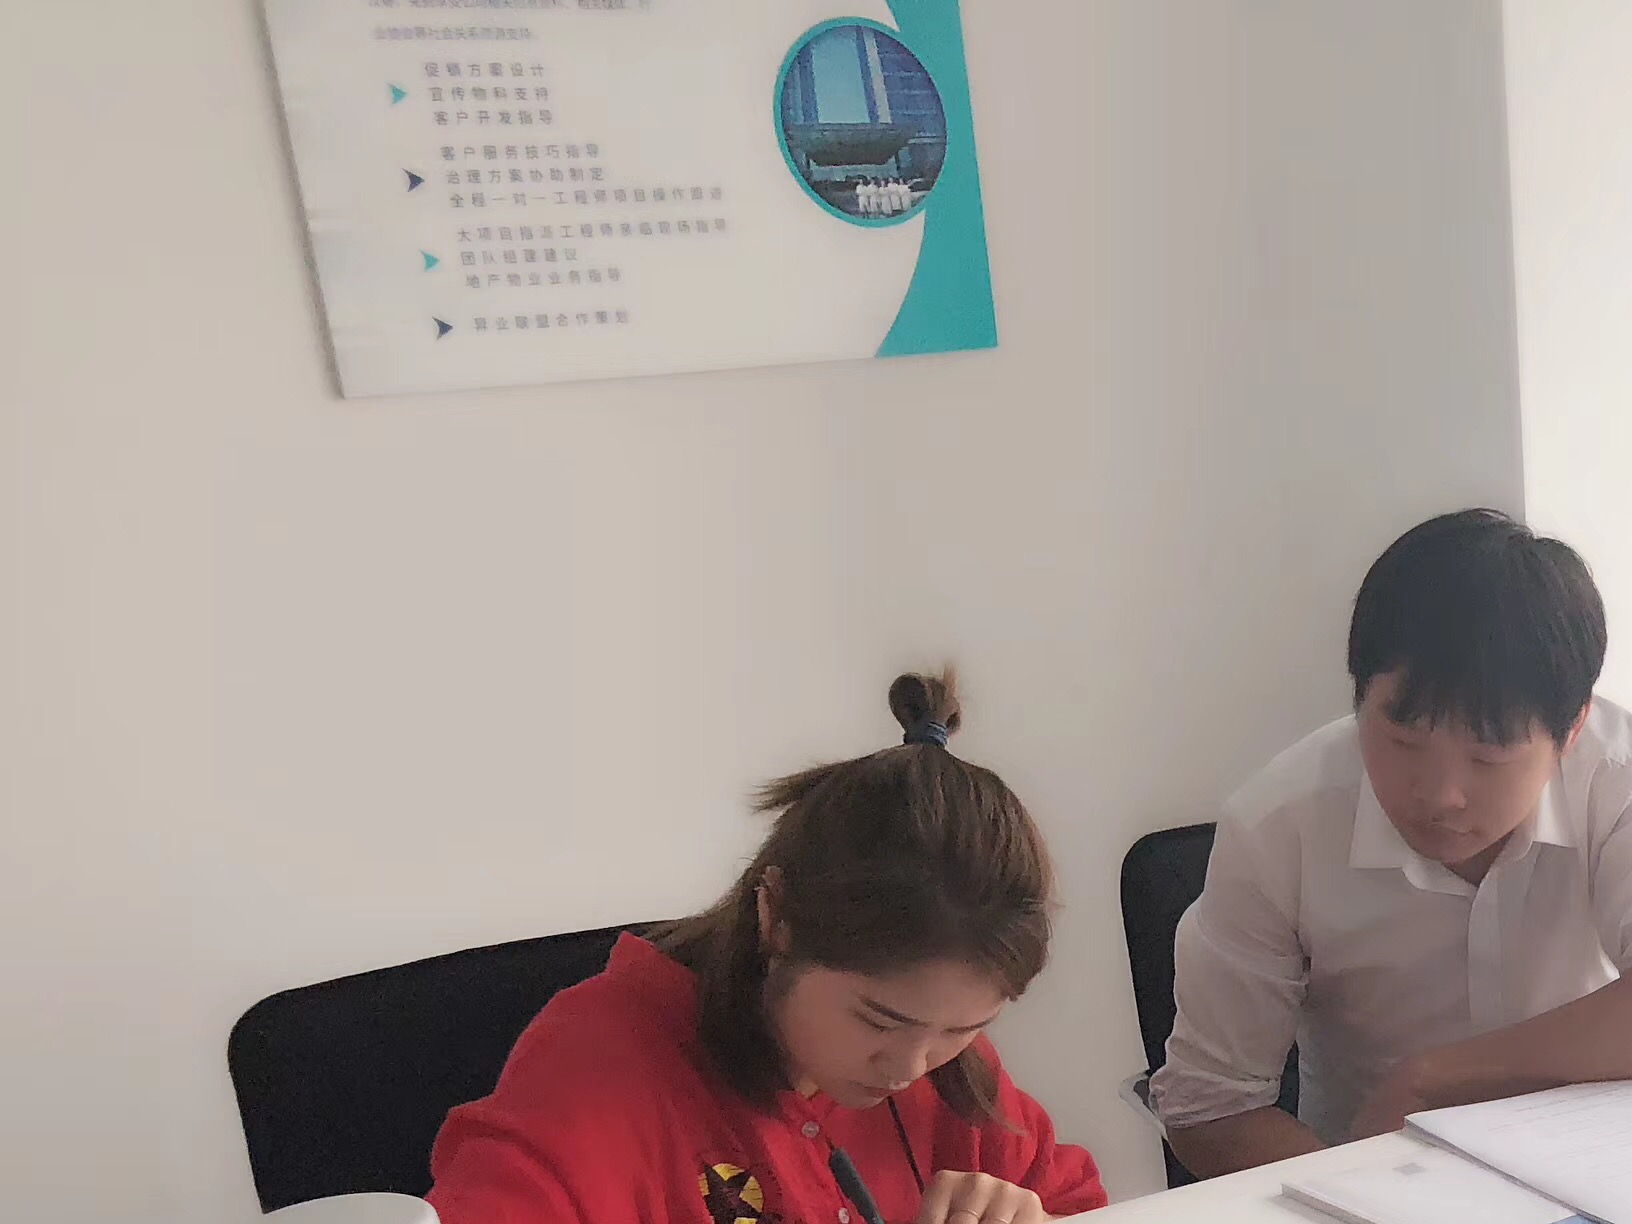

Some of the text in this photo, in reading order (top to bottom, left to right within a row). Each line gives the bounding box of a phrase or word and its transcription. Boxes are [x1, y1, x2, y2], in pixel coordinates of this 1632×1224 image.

[424, 62, 545, 78] 促销方案设计
[428, 86, 549, 102] 宣传物料支持
[434, 109, 553, 126] 客户开发指导
[440, 143, 600, 161] 客户服务技巧指导
[461, 247, 578, 266] 团队组建建议
